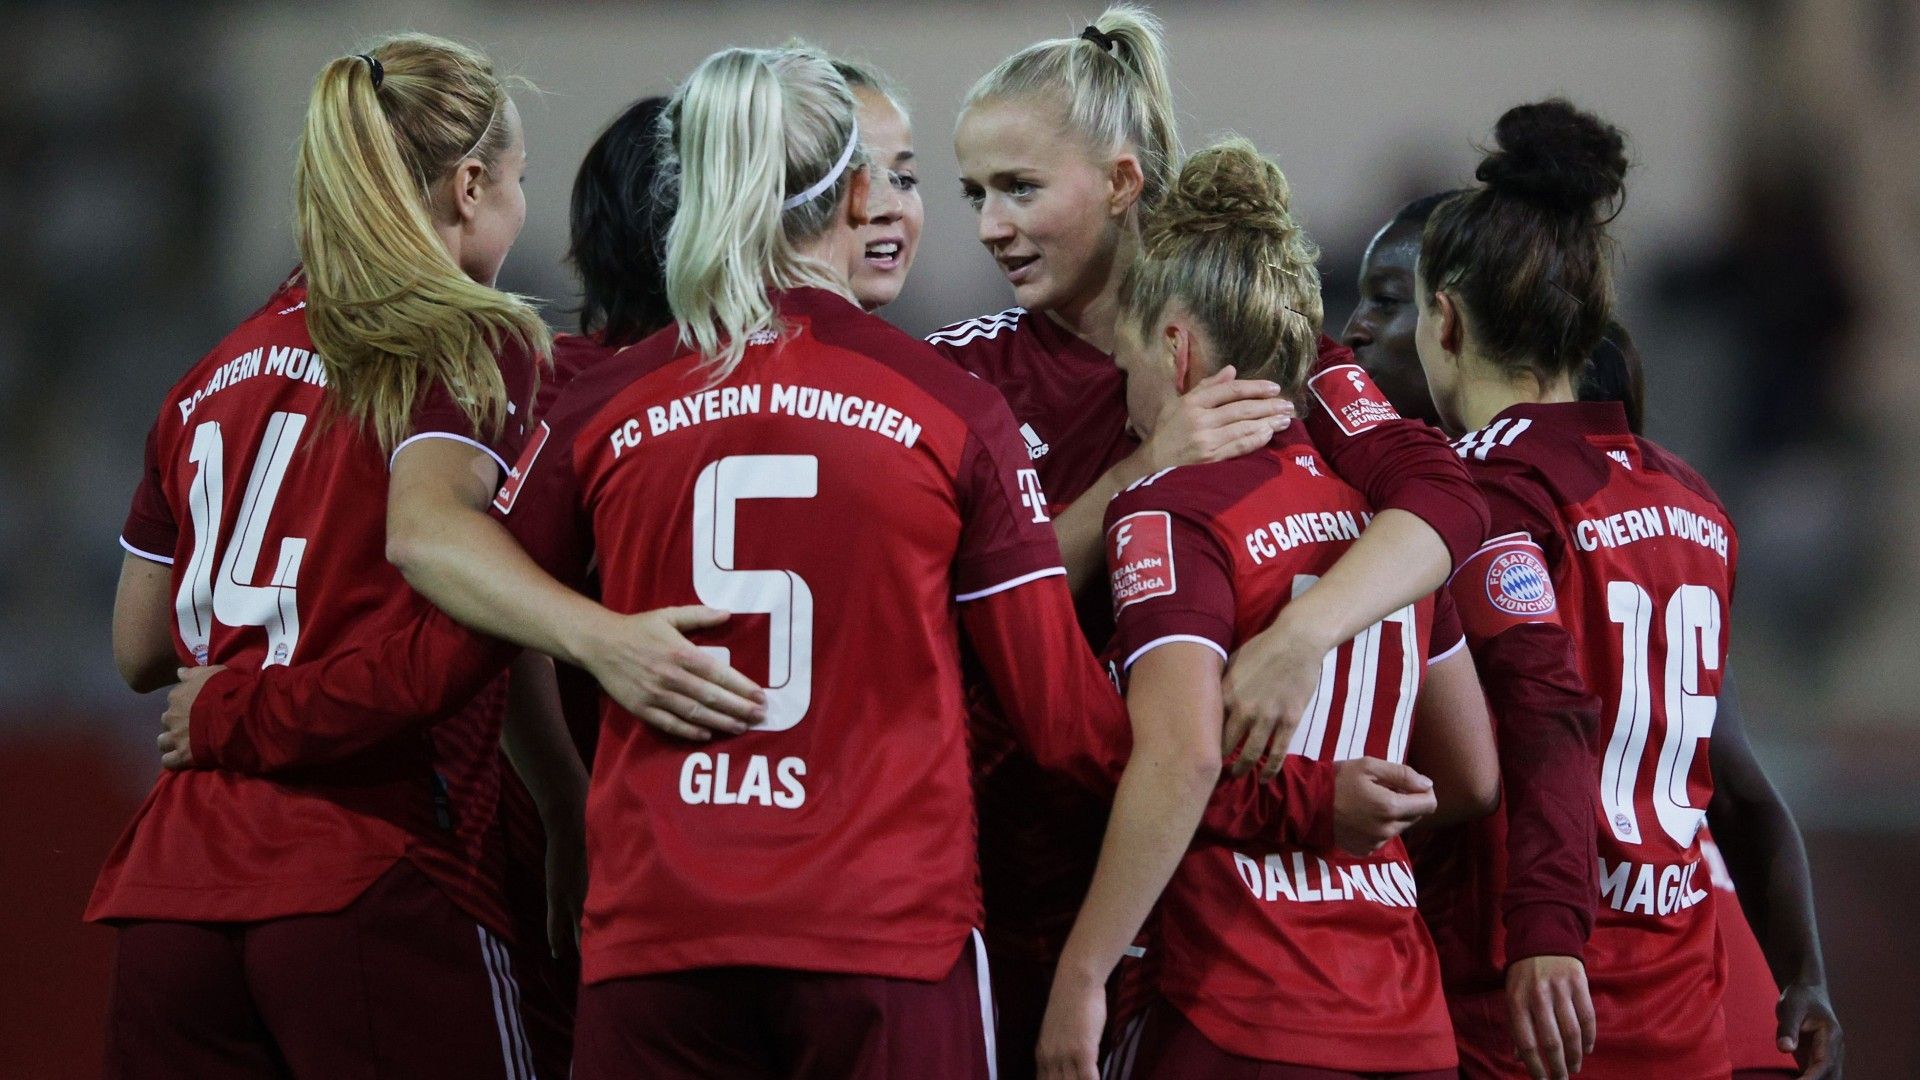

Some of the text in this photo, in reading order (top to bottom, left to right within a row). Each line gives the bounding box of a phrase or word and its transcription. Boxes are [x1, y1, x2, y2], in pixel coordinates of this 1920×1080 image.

[609, 383, 922, 459] FC BAYERN MÜNCHEN
[176, 410, 308, 671] 14
[1245, 528, 1277, 565] FC
[1268, 510, 1361, 551] BAYERN
[692, 454, 819, 731] 5
[679, 751, 808, 809] GLAS
